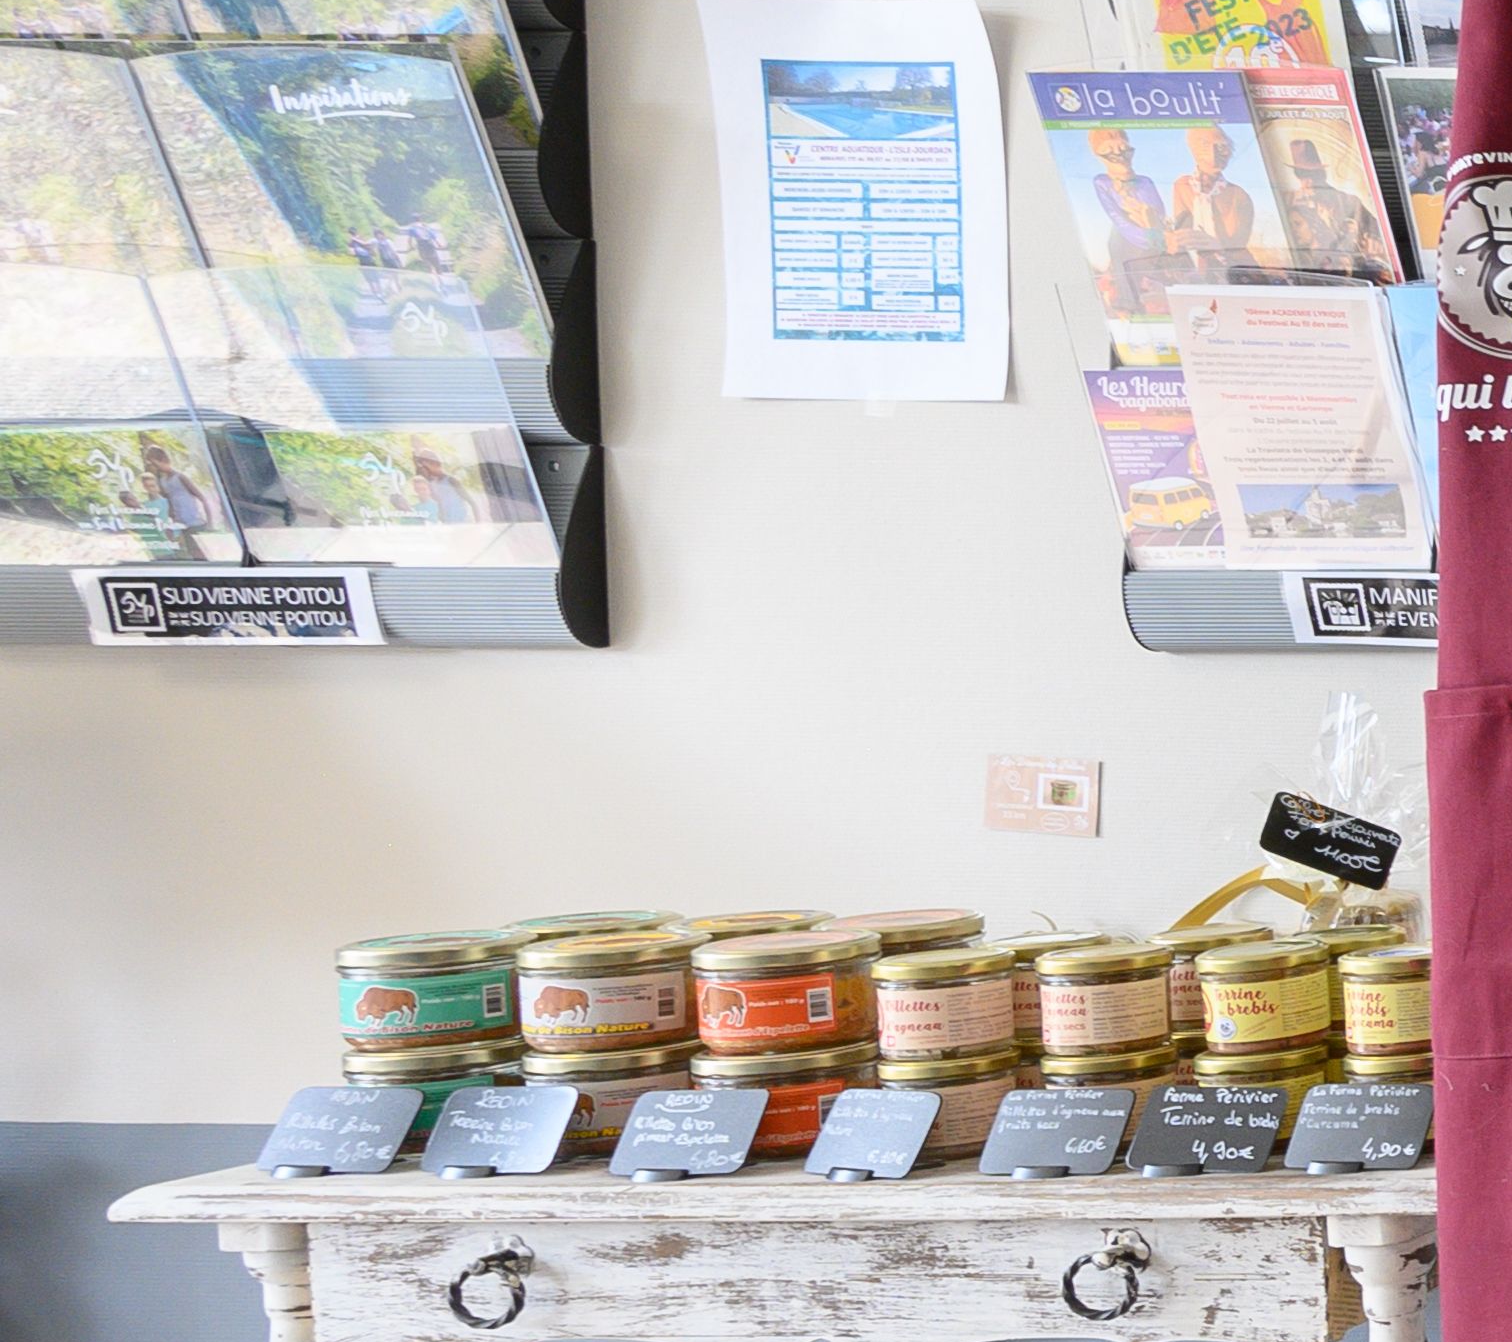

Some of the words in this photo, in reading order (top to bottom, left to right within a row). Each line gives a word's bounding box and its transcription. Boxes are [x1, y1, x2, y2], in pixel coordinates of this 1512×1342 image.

[269, 77, 412, 123] Inspirations
[1083, 82, 1115, 116] la
[1128, 81, 1224, 116] boulit'
[1437, 374, 1496, 422] qui
[163, 587, 203, 605] SUD
[206, 587, 270, 605] VIENNE
[274, 587, 346, 605] POITOU
[191, 610, 220, 627] SUD
[222, 610, 281, 627] VIENNE
[283, 610, 346, 627] POITOU
[1192, 1141, 1255, 1162] 4,90€
[1361, 1136, 1415, 1161] 4,90€
